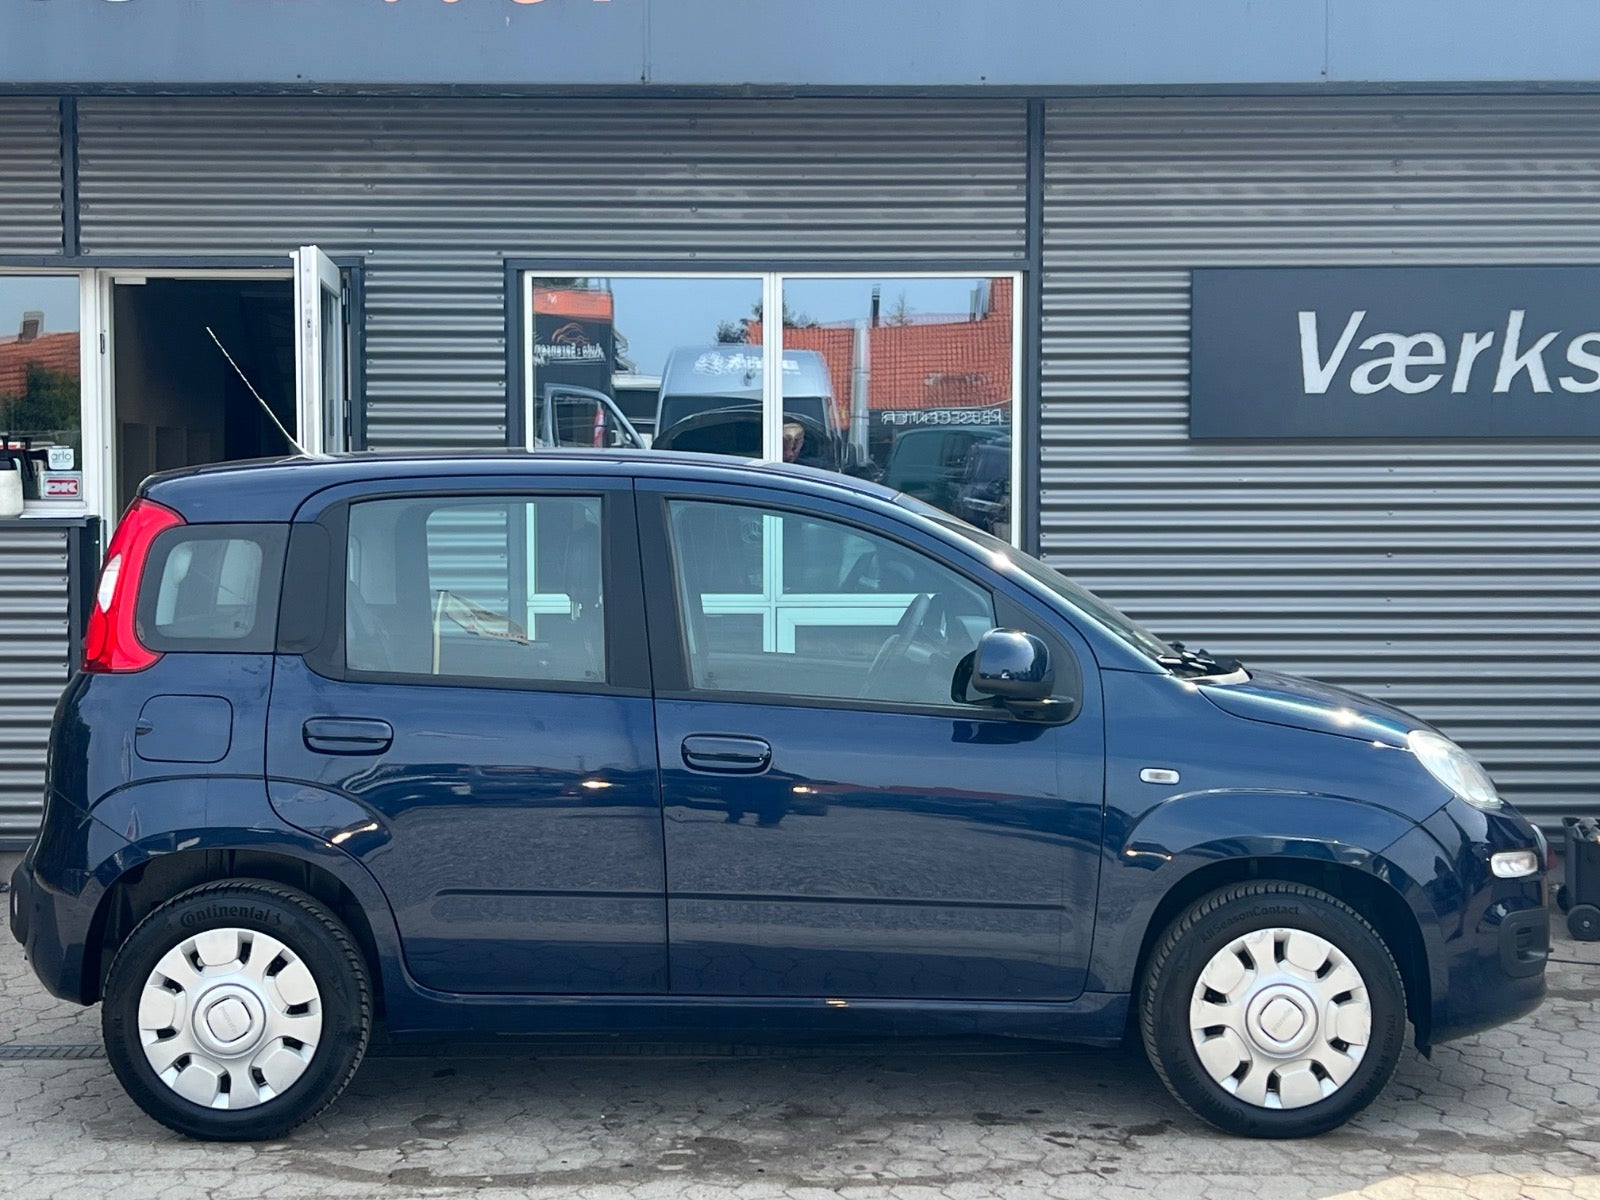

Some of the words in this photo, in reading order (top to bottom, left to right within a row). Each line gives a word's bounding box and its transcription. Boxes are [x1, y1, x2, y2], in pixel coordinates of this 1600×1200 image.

[1298, 309, 1600, 394] Værks
[180, 904, 271, 928] Continental
[1202, 904, 1300, 944] AllSeasonContact
